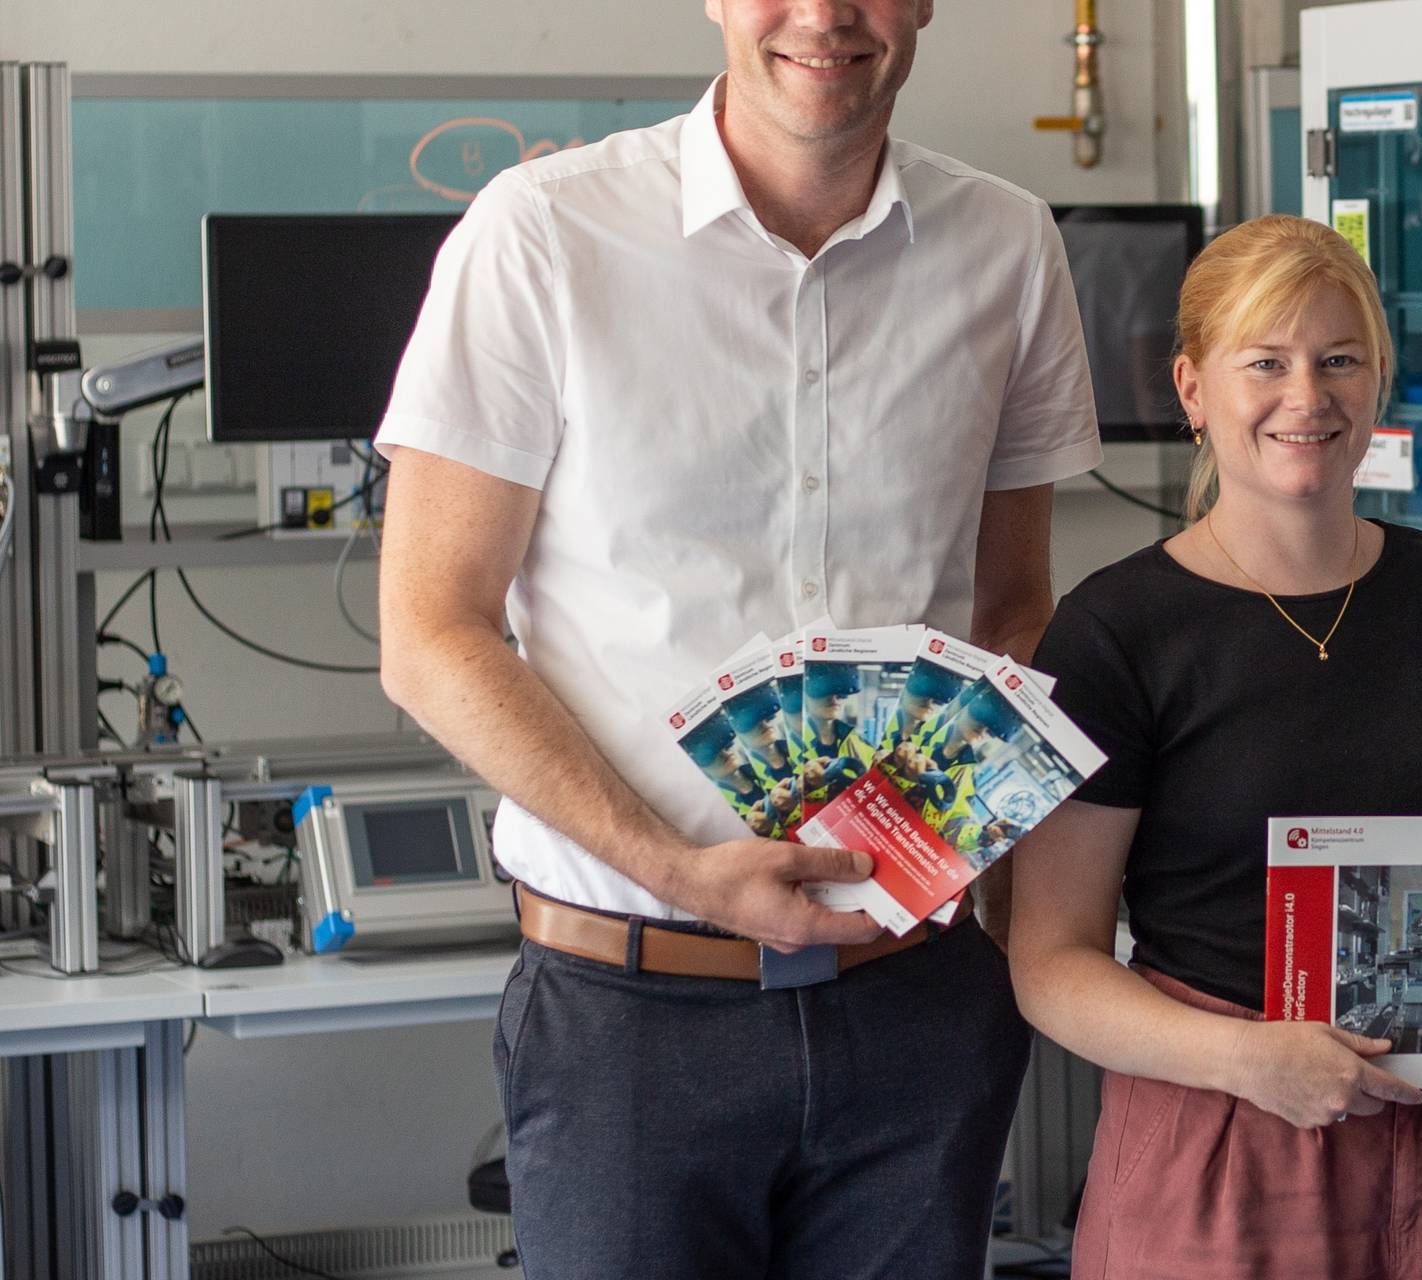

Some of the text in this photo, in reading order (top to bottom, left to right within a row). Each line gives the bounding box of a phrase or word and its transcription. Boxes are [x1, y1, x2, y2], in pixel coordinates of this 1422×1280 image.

[863, 800, 893, 831] digitale
[888, 825, 939, 877] Transformation
[873, 792, 890, 810] Wir
[885, 805, 904, 825] sind
[907, 829, 940, 863] Begleiter
